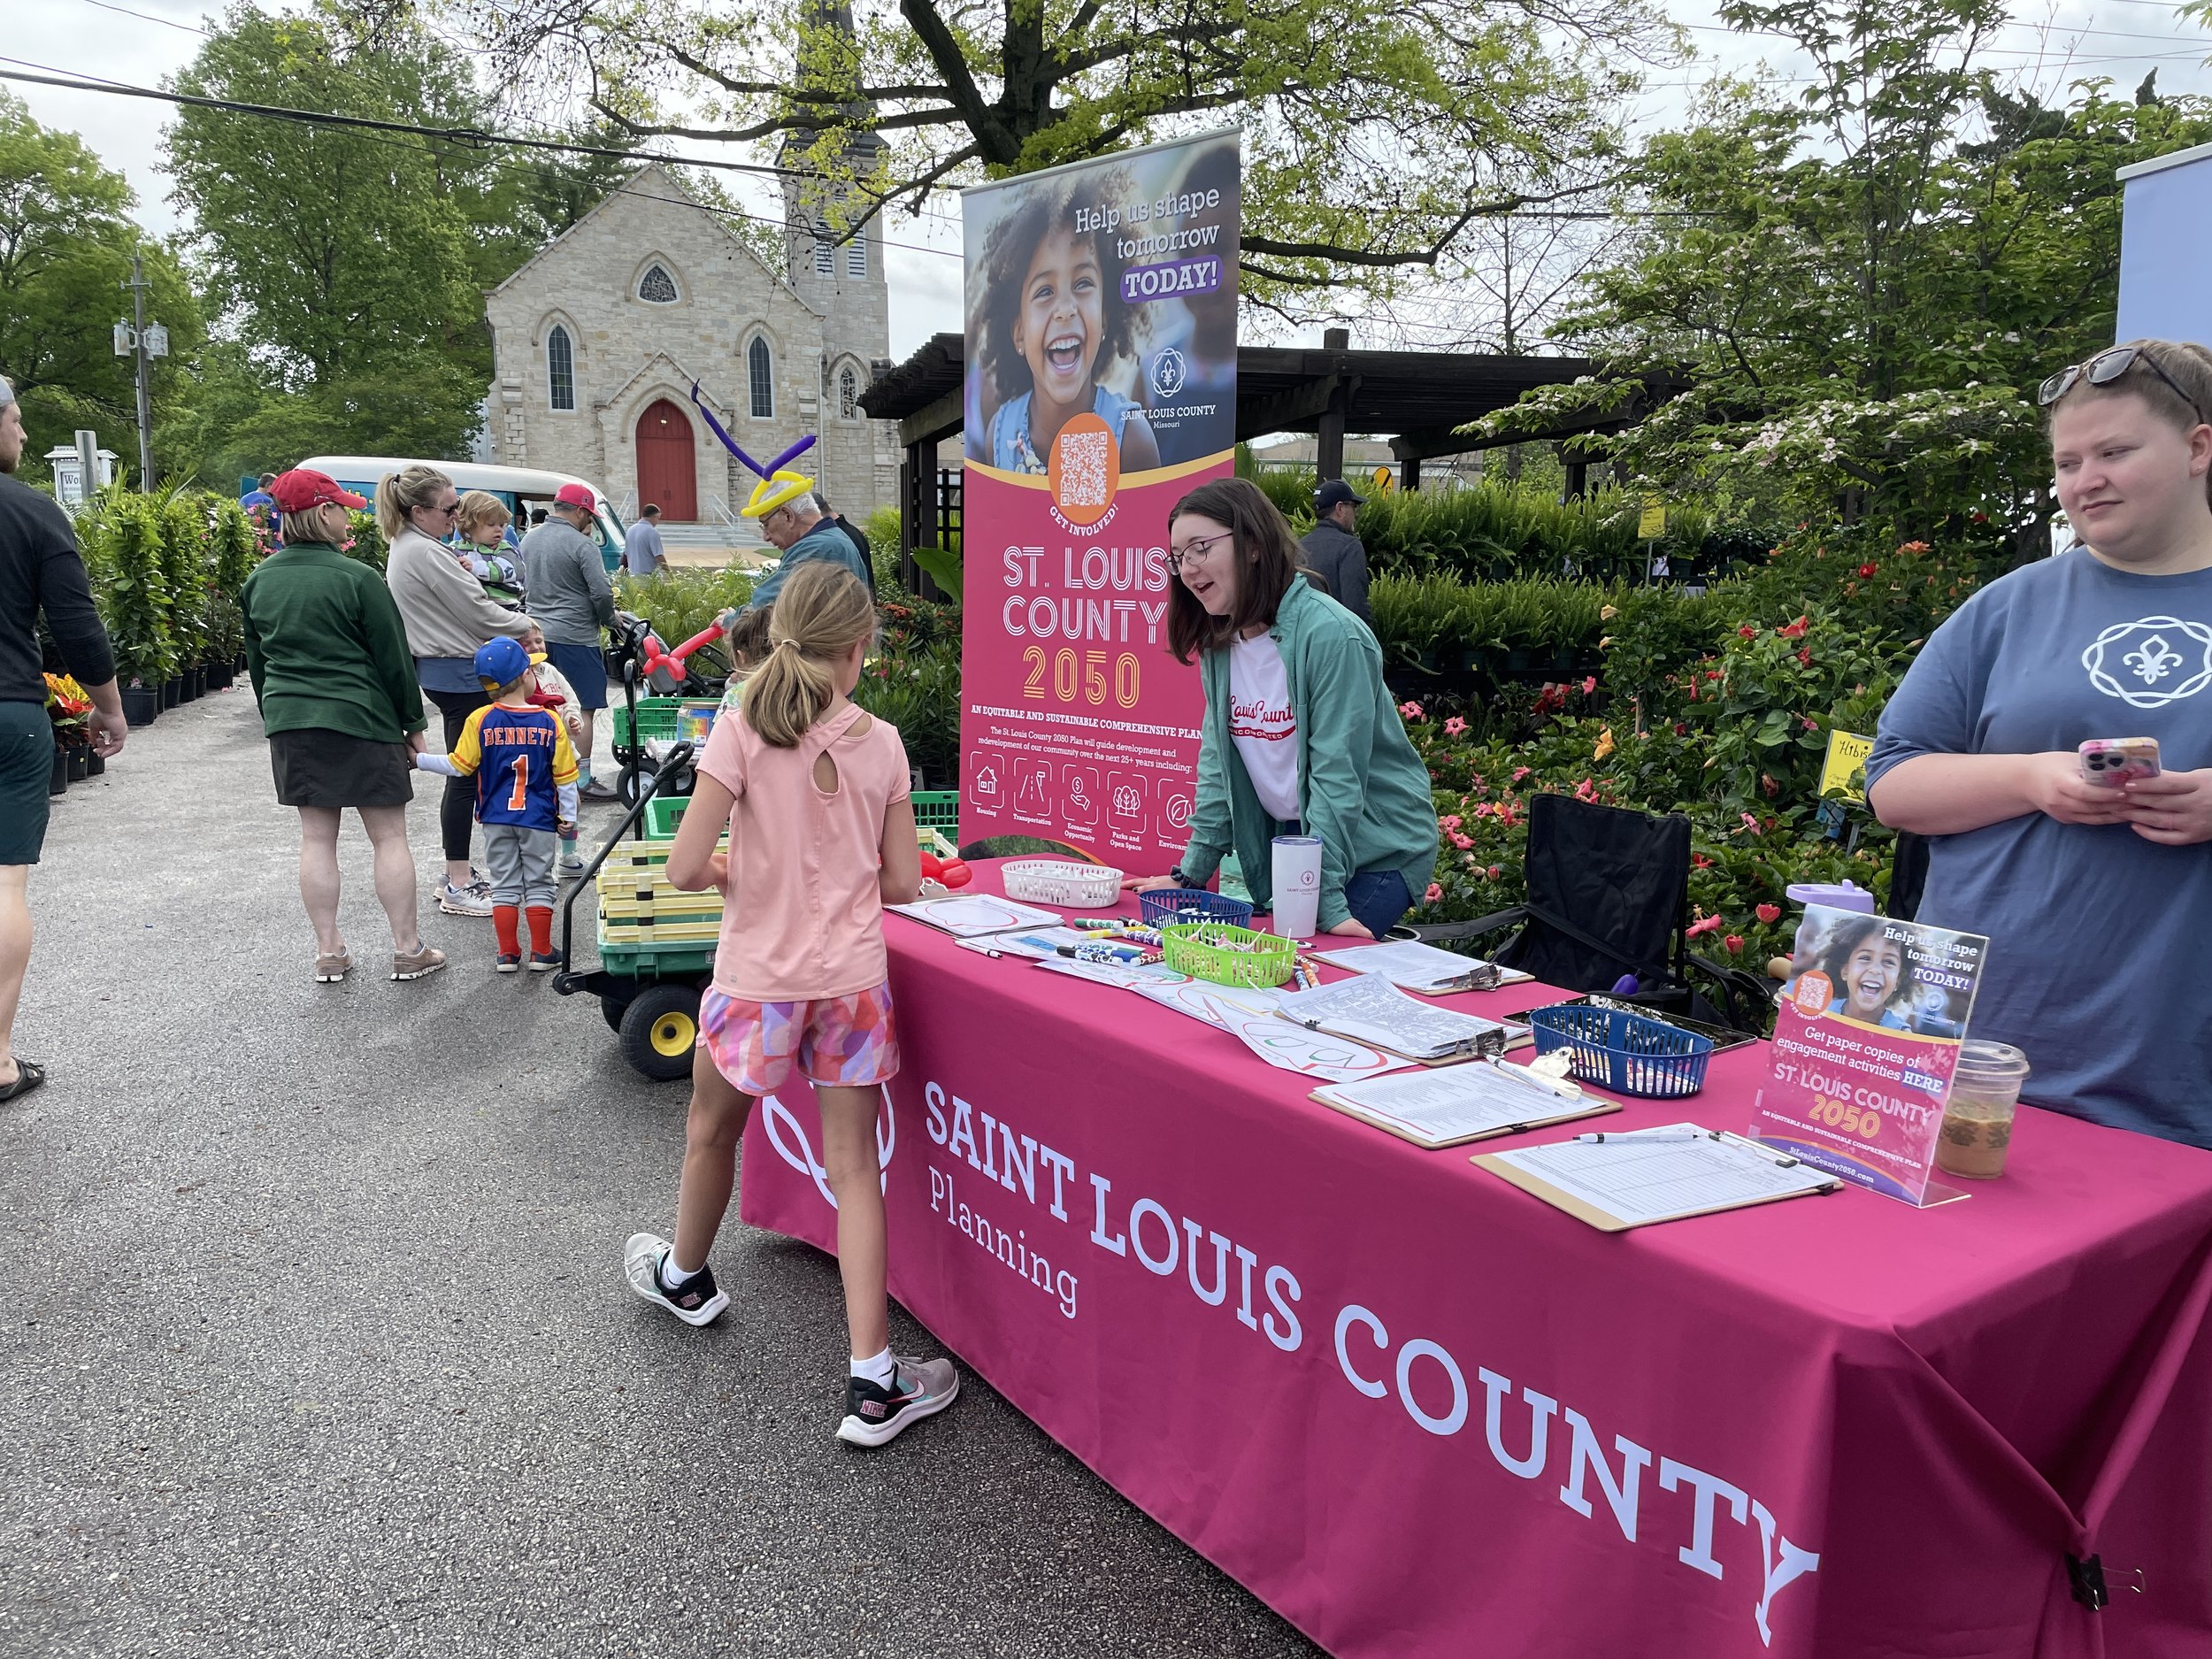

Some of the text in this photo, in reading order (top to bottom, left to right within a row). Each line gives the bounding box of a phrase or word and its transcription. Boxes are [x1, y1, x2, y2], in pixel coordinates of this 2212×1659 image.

[1075, 188, 1220, 234] Help us shape
[1117, 224, 1220, 259] tomorrow
[1125, 263, 1218, 297] TODAY!
[1120, 404, 1216, 421] SAINT LOUIS COUNTY
[1153, 419, 1180, 429] Missouri
[65, 475, 81, 484] Wo
[1049, 503, 1119, 537] GET INVOLVED!
[1003, 545, 1168, 592] ST. LOUIS
[1003, 595, 1168, 644] COUNTY
[1023, 645, 1141, 709] 2050
[972, 704, 1203, 740] AN EQUITABLE AND SUSTAINABLE COMPREHENSIVE PLAN
[1256, 700, 1294, 723] Count
[483, 726, 554, 748] BENNETT
[990, 726, 1002, 735] The
[1010, 729, 1026, 739] Louis
[1028, 731, 1052, 743] County
[1053, 733, 1069, 743] 2050
[1070, 736, 1083, 745] Plan
[1084, 738, 1094, 747] will
[1096, 741, 1115, 750] guide
[1116, 742, 1161, 756] development
[978, 737, 1023, 749] redevelopment
[1023, 741, 1030, 750] of
[1043, 746, 1079, 758] community
[1094, 751, 1104, 760] the
[1105, 753, 1119, 762] next
[1121, 755, 1133, 764] 25+
[1135, 758, 1154, 768] years
[1156, 760, 1193, 774] including:
[507, 754, 528, 810] 1
[976, 807, 997, 818] Housing
[1013, 813, 1052, 826] Transportation
[1067, 822, 1093, 833] Economic
[1064, 830, 1095, 843] Opportunity
[1110, 840, 1142, 851] Open Space
[1112, 832, 1129, 841] Parks
[1884, 926, 1978, 957] Help us shape
[1907, 949, 1975, 972] tomorrow
[1914, 968, 1970, 990] TODAY!
[1805, 1026, 1921, 1069] Get paper copies of
[1777, 1037, 1944, 1094] engagement activities HERE
[1800, 1069, 1852, 1101] LOUIS
[1855, 1087, 1936, 1125] COUNTY
[1808, 1094, 1881, 1138] 2050
[1770, 1112, 1801, 1128] EQUITABLE
[1801, 1122, 1814, 1132] AND
[1814, 1127, 1852, 1146] SUSTAINABLE
[1905, 1159, 1922, 1168] PLAN
[1789, 1146, 1874, 1183] StLouisCounty2050.com
[928, 1164, 1079, 1319] Planning
[925, 1080, 1820, 1647] SAINT LOUIS COUNTY
